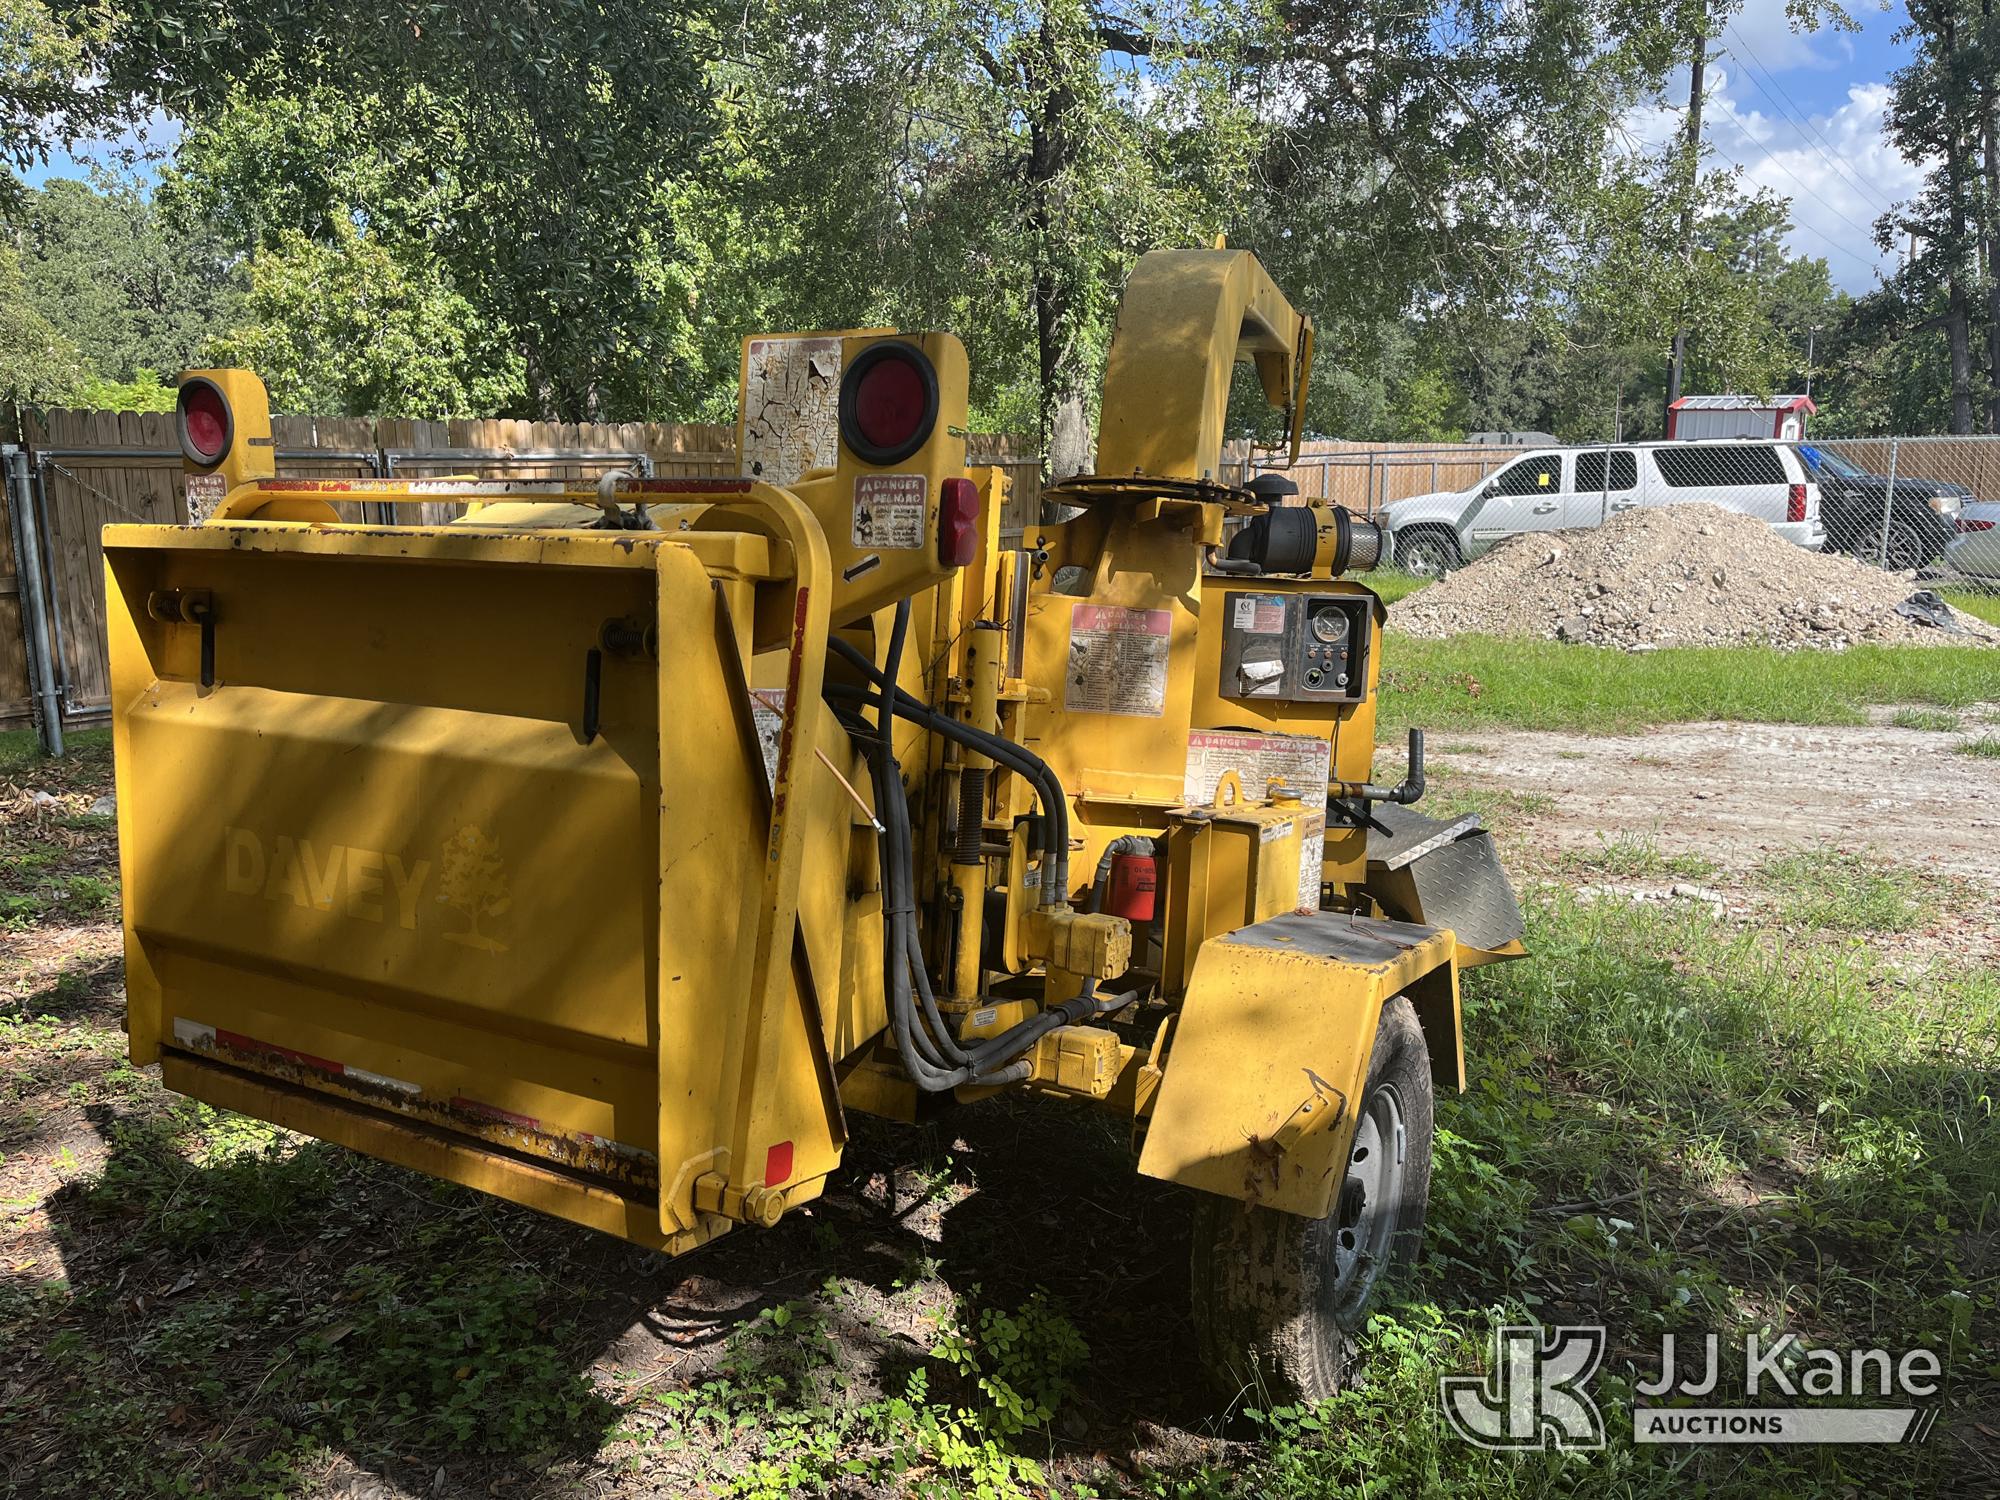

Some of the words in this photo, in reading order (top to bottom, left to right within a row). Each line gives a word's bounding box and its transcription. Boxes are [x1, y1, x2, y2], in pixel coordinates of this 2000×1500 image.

[873, 479, 920, 490] DANGER
[1107, 610, 1146, 621] DANGER
[1205, 737, 1248, 747] DANGER
[224, 826, 431, 930] DAVEY
